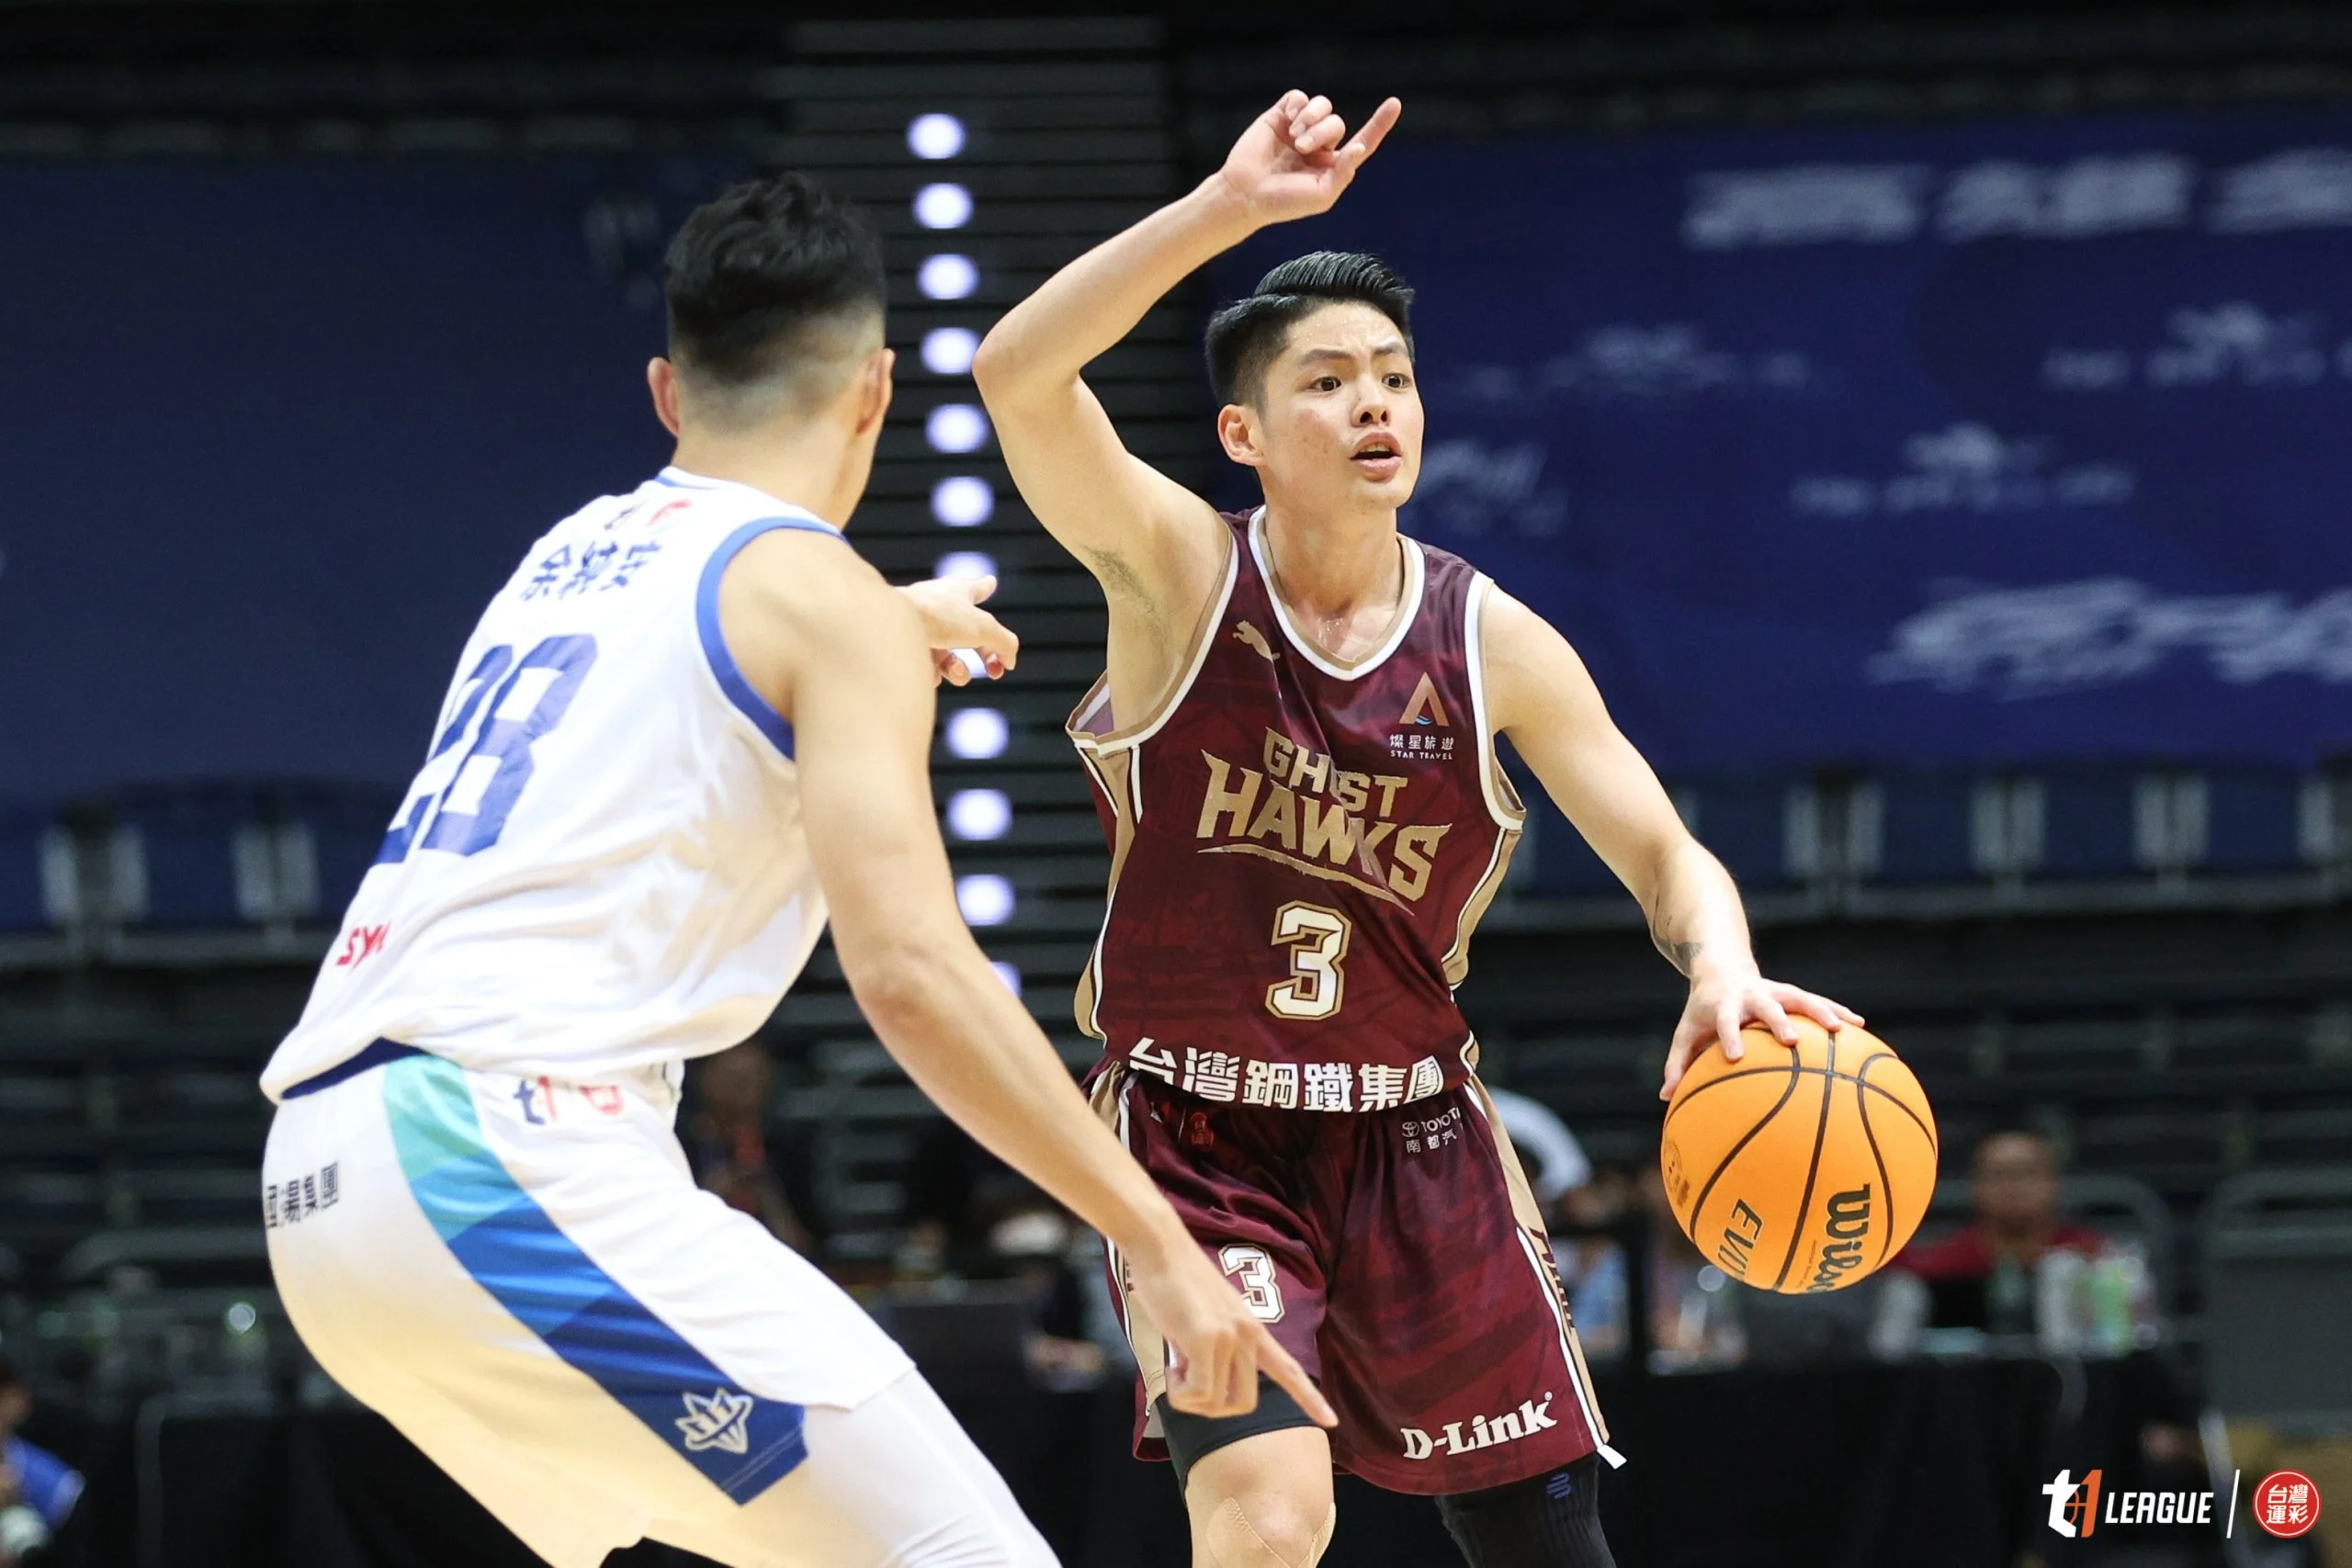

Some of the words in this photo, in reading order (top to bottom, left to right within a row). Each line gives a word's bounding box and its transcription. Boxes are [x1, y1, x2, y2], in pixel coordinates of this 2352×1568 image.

[373, 634, 599, 863] 28
[1263, 726, 1408, 818] GHST
[1390, 750, 1415, 760] STAR
[1419, 752, 1453, 761] TRAVEL
[1196, 749, 1453, 902] HAWKS
[1266, 900, 1351, 1021] 3
[1406, 1123, 1464, 1154] 南都汽
[1217, 1243, 1286, 1324] 3
